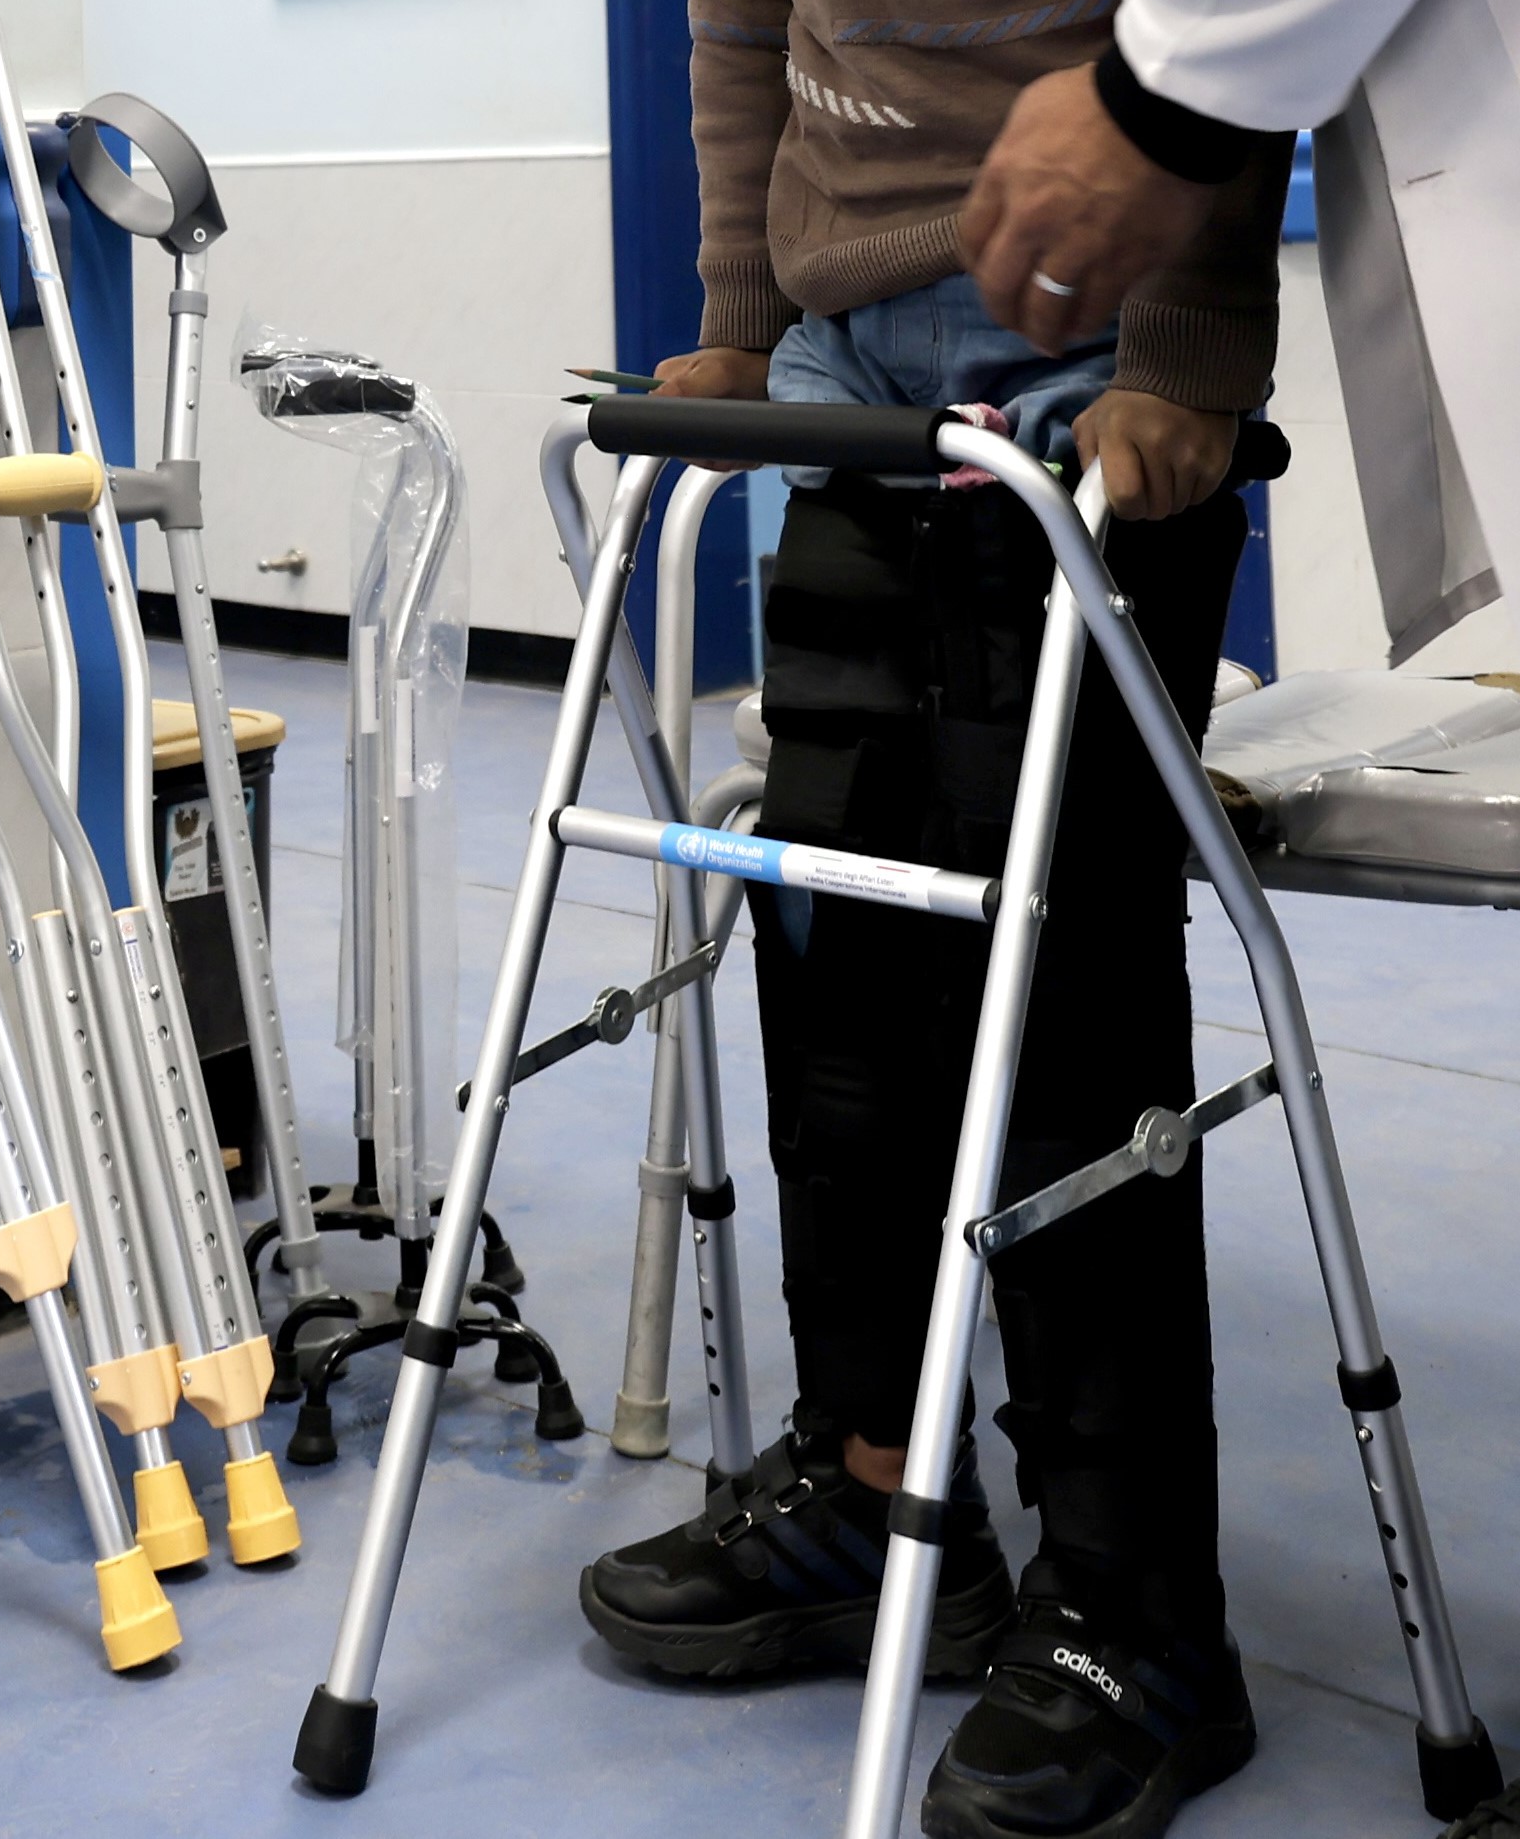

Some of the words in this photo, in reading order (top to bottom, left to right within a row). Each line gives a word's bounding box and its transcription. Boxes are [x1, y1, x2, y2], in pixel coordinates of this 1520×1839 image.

[709, 839, 737, 855] World
[735, 842, 765, 859] Health
[706, 851, 763, 873] Organization
[1053, 1646, 1123, 1702] adidas
